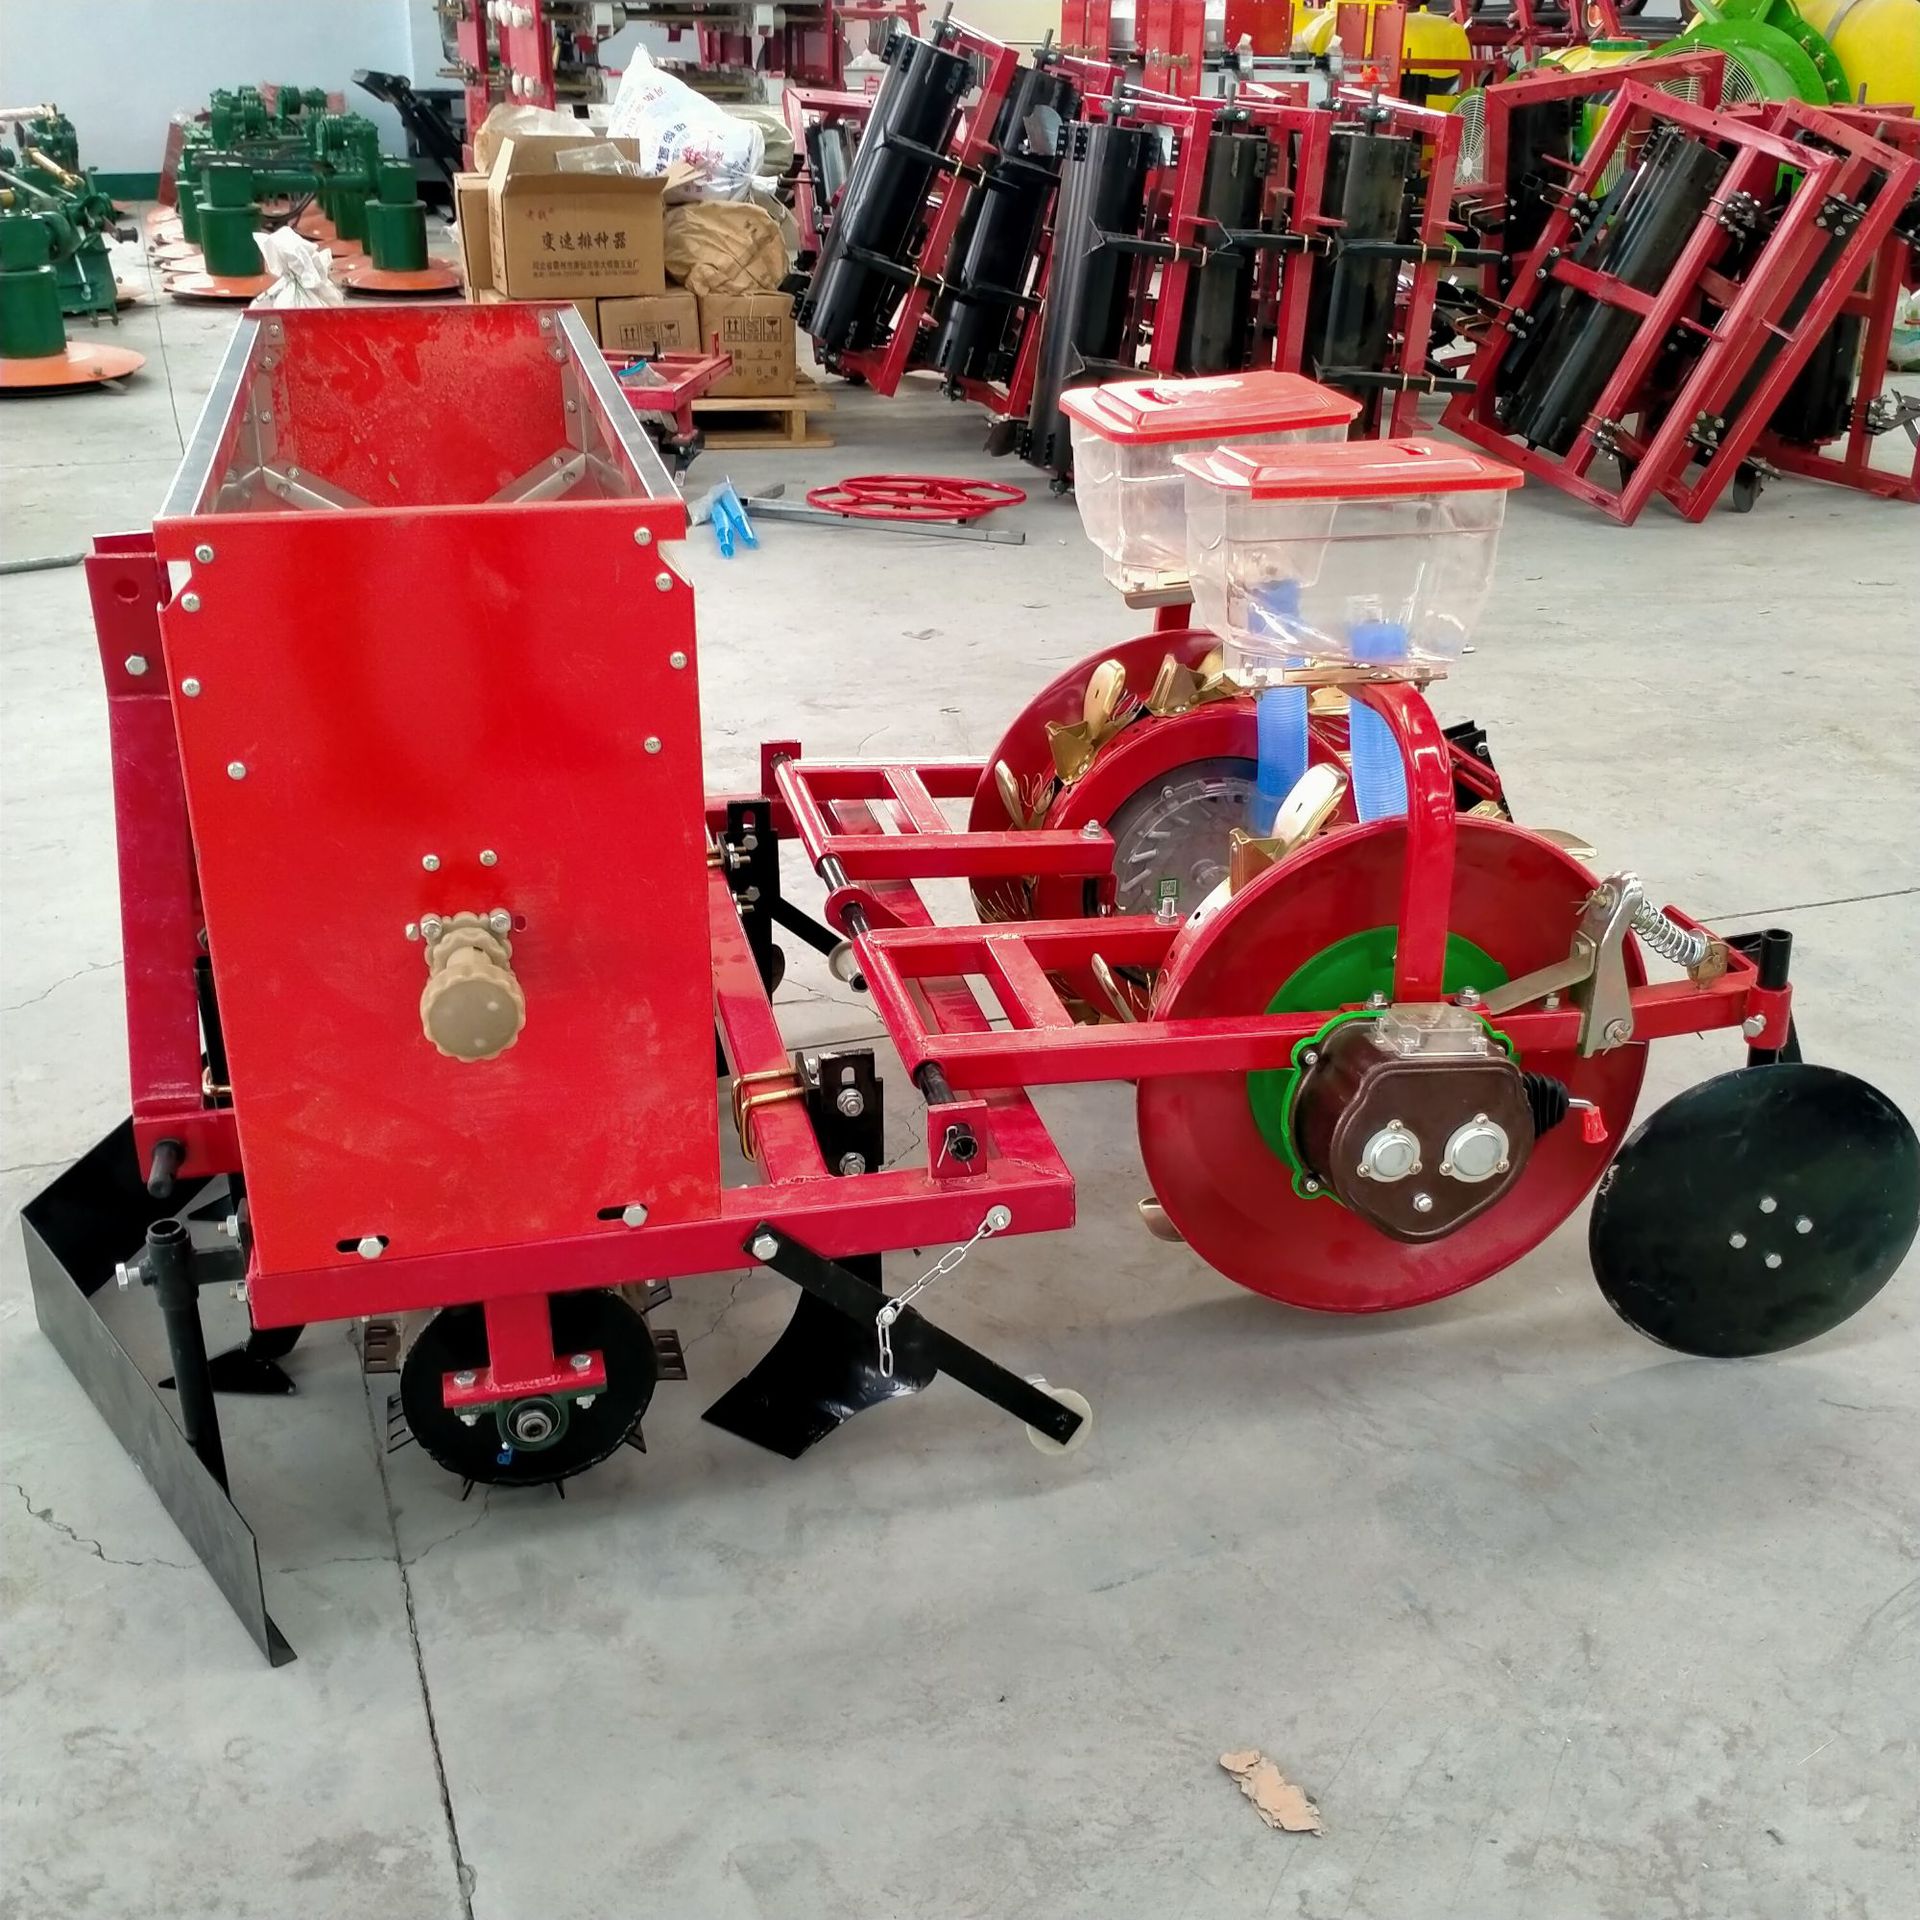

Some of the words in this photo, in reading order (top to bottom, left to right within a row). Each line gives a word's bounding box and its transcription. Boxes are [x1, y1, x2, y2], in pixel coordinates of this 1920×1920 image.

[541, 231, 627, 251] 变速排种器
